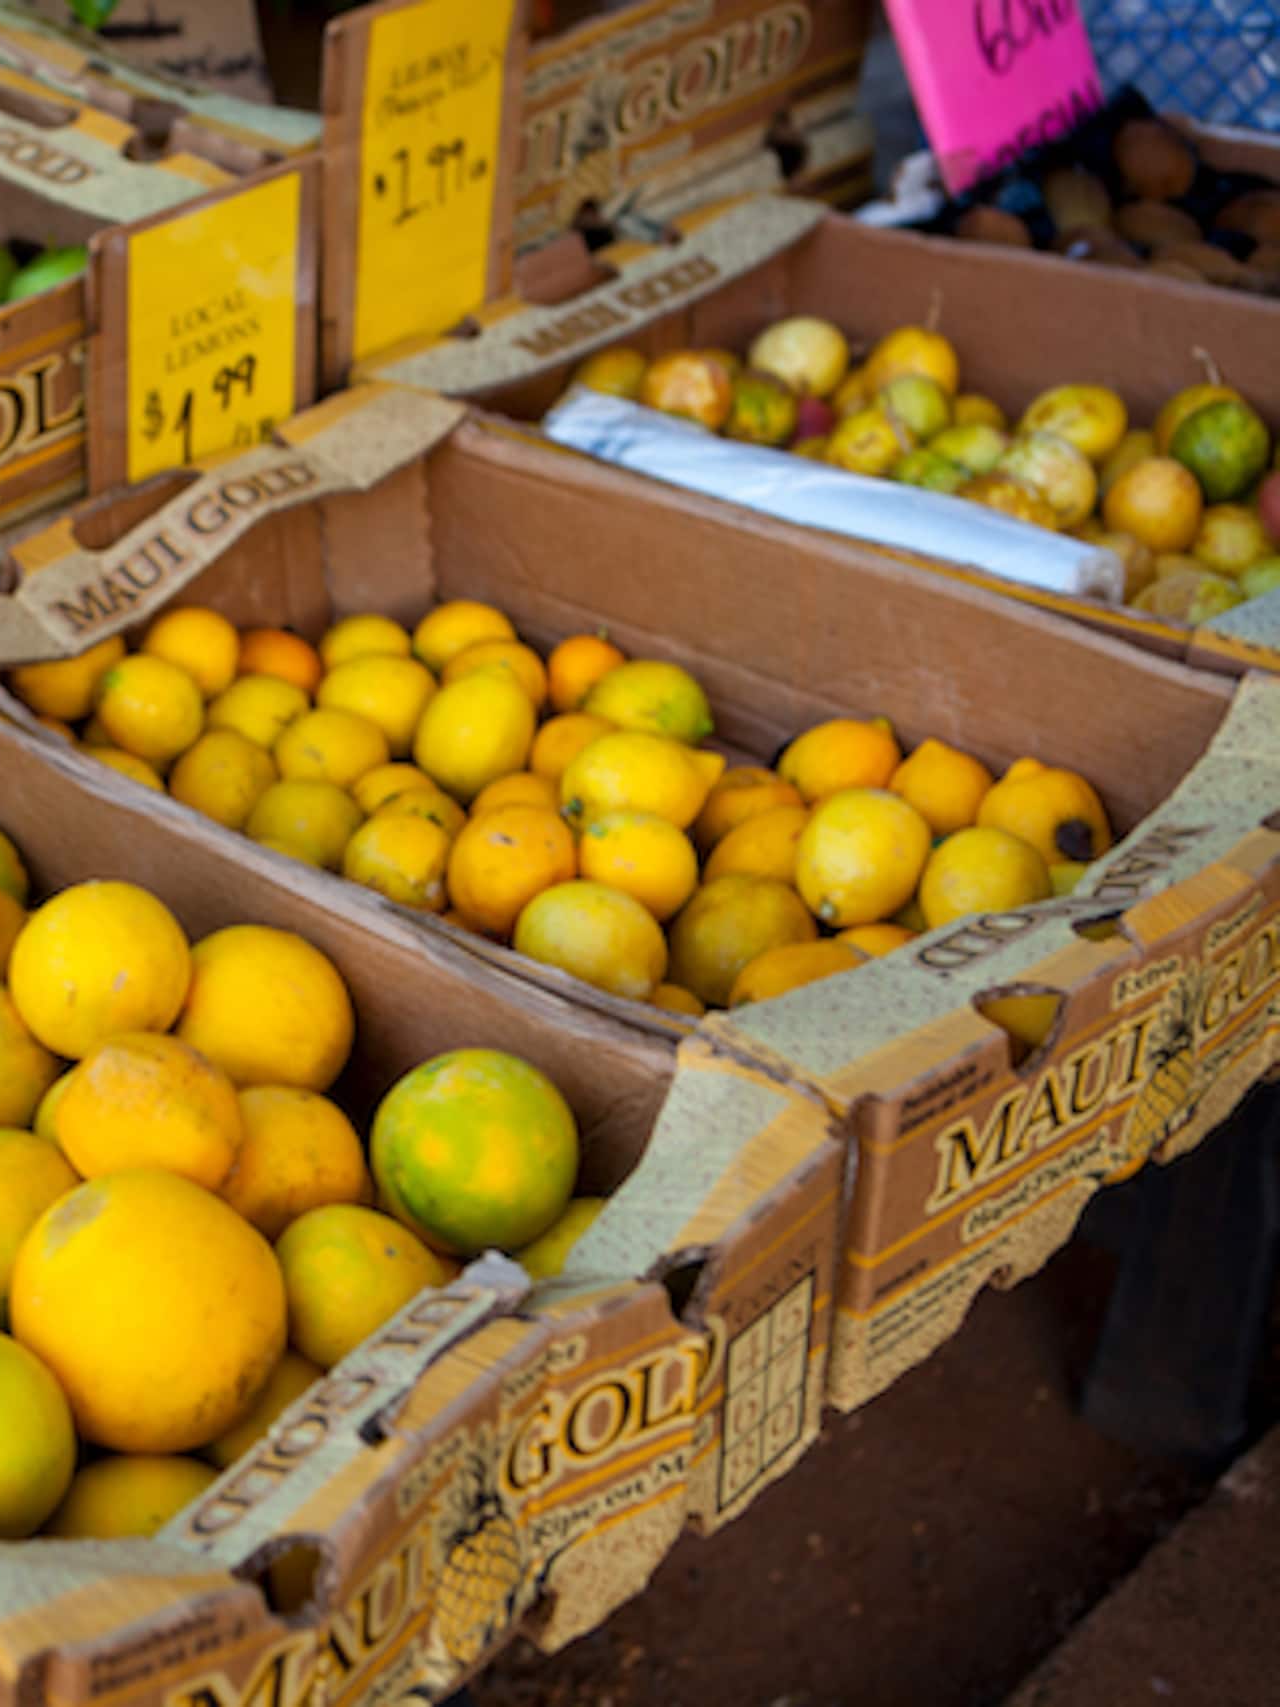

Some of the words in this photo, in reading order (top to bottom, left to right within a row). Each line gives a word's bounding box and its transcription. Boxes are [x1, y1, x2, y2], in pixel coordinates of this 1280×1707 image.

[163, 316, 261, 374] LEMONS
[50, 530, 186, 636] MAUI
[184, 460, 317, 536] GOLD
[933, 1015, 1148, 1200] MAUI
[505, 1325, 720, 1492] GOLD
